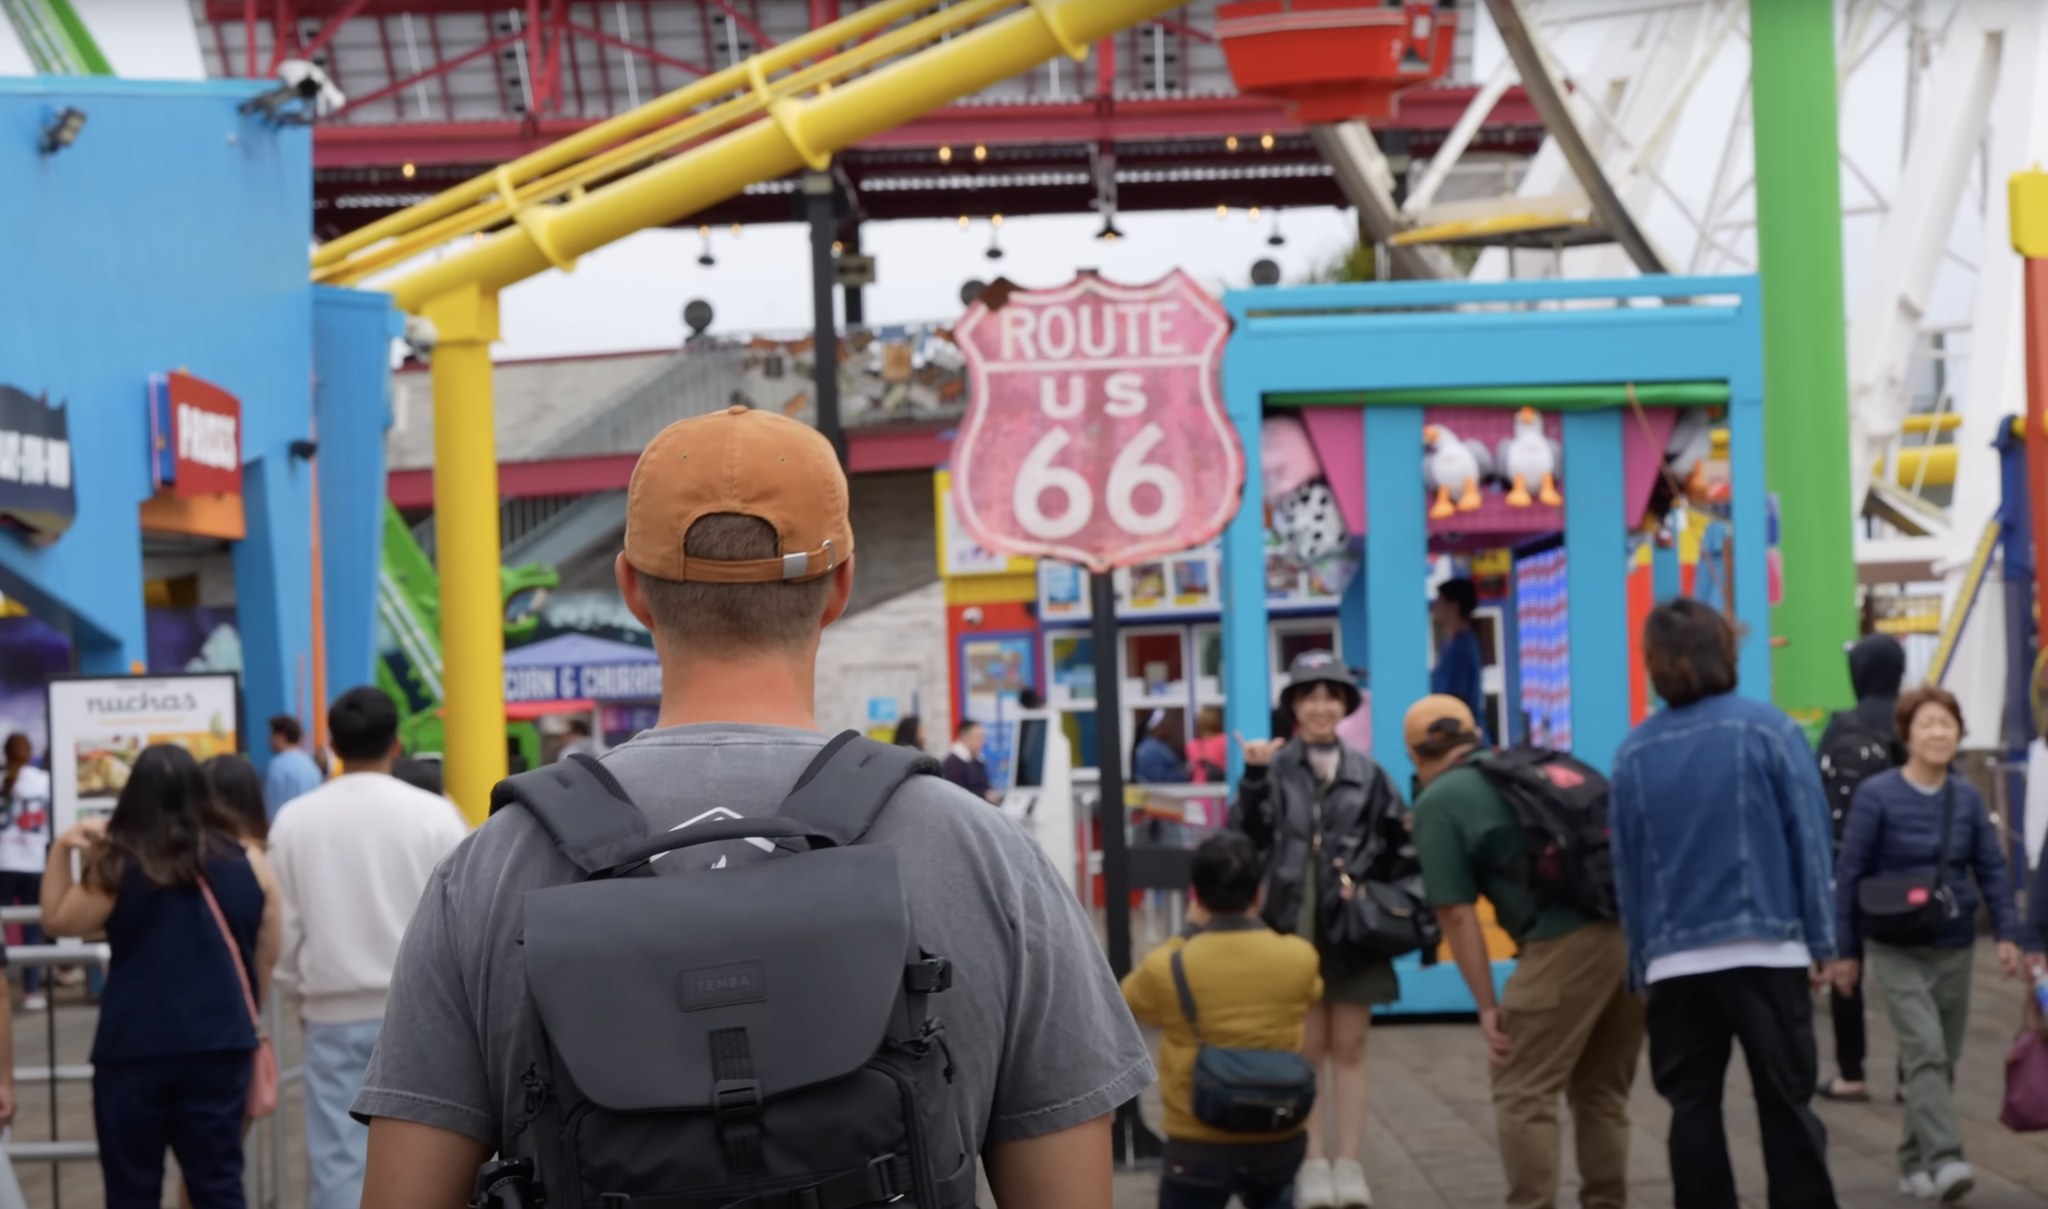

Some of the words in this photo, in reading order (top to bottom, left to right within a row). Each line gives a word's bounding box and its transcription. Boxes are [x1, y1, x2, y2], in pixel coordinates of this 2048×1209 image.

[1001, 302, 1183, 359] ROUTE
[1012, 421, 1186, 541] 66
[86, 690, 197, 713] nuchas
[696, 975, 751, 993] TENBA
